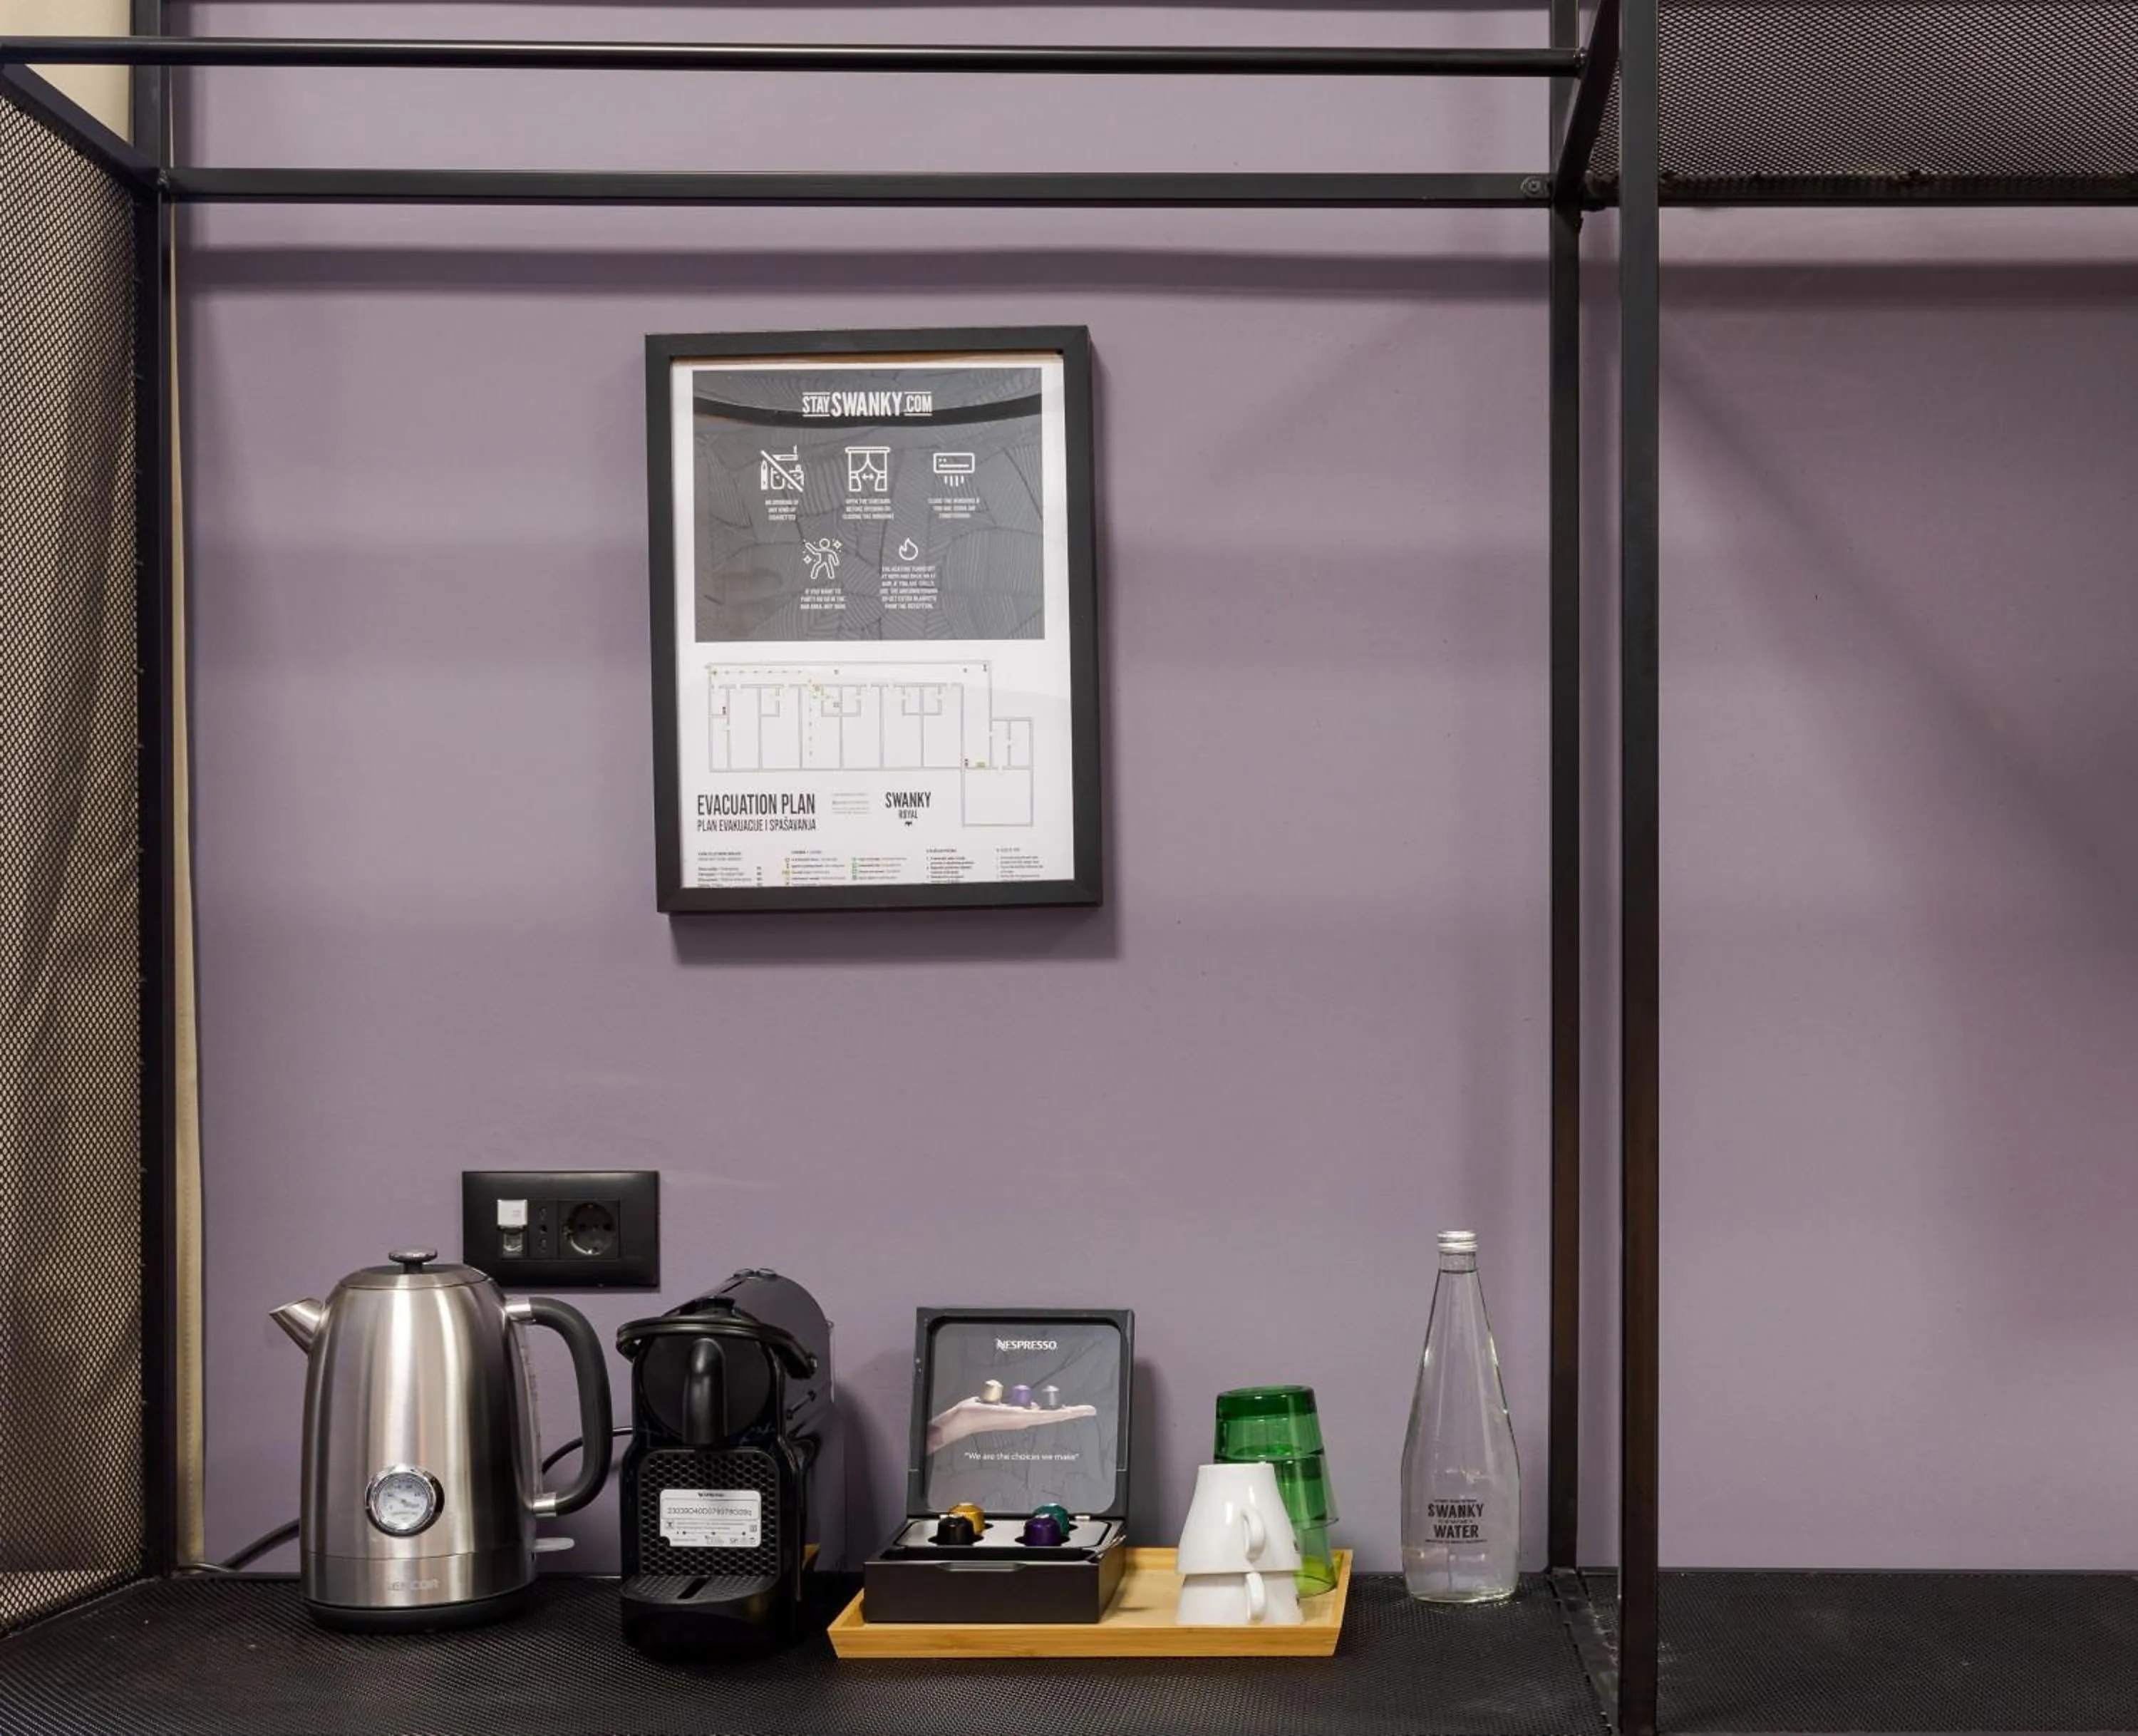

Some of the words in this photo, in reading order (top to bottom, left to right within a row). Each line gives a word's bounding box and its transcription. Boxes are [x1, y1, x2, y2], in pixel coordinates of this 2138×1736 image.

[697, 793, 778, 815] EVACUATION
[781, 793, 815, 815] PLAN
[885, 791, 931, 808] SWANKY
[697, 820, 717, 832] PLAN
[996, 1338, 1058, 1352] NESPRESSO
[1427, 1503, 1484, 1518] SWANKY
[1433, 1524, 1479, 1539] WATER
